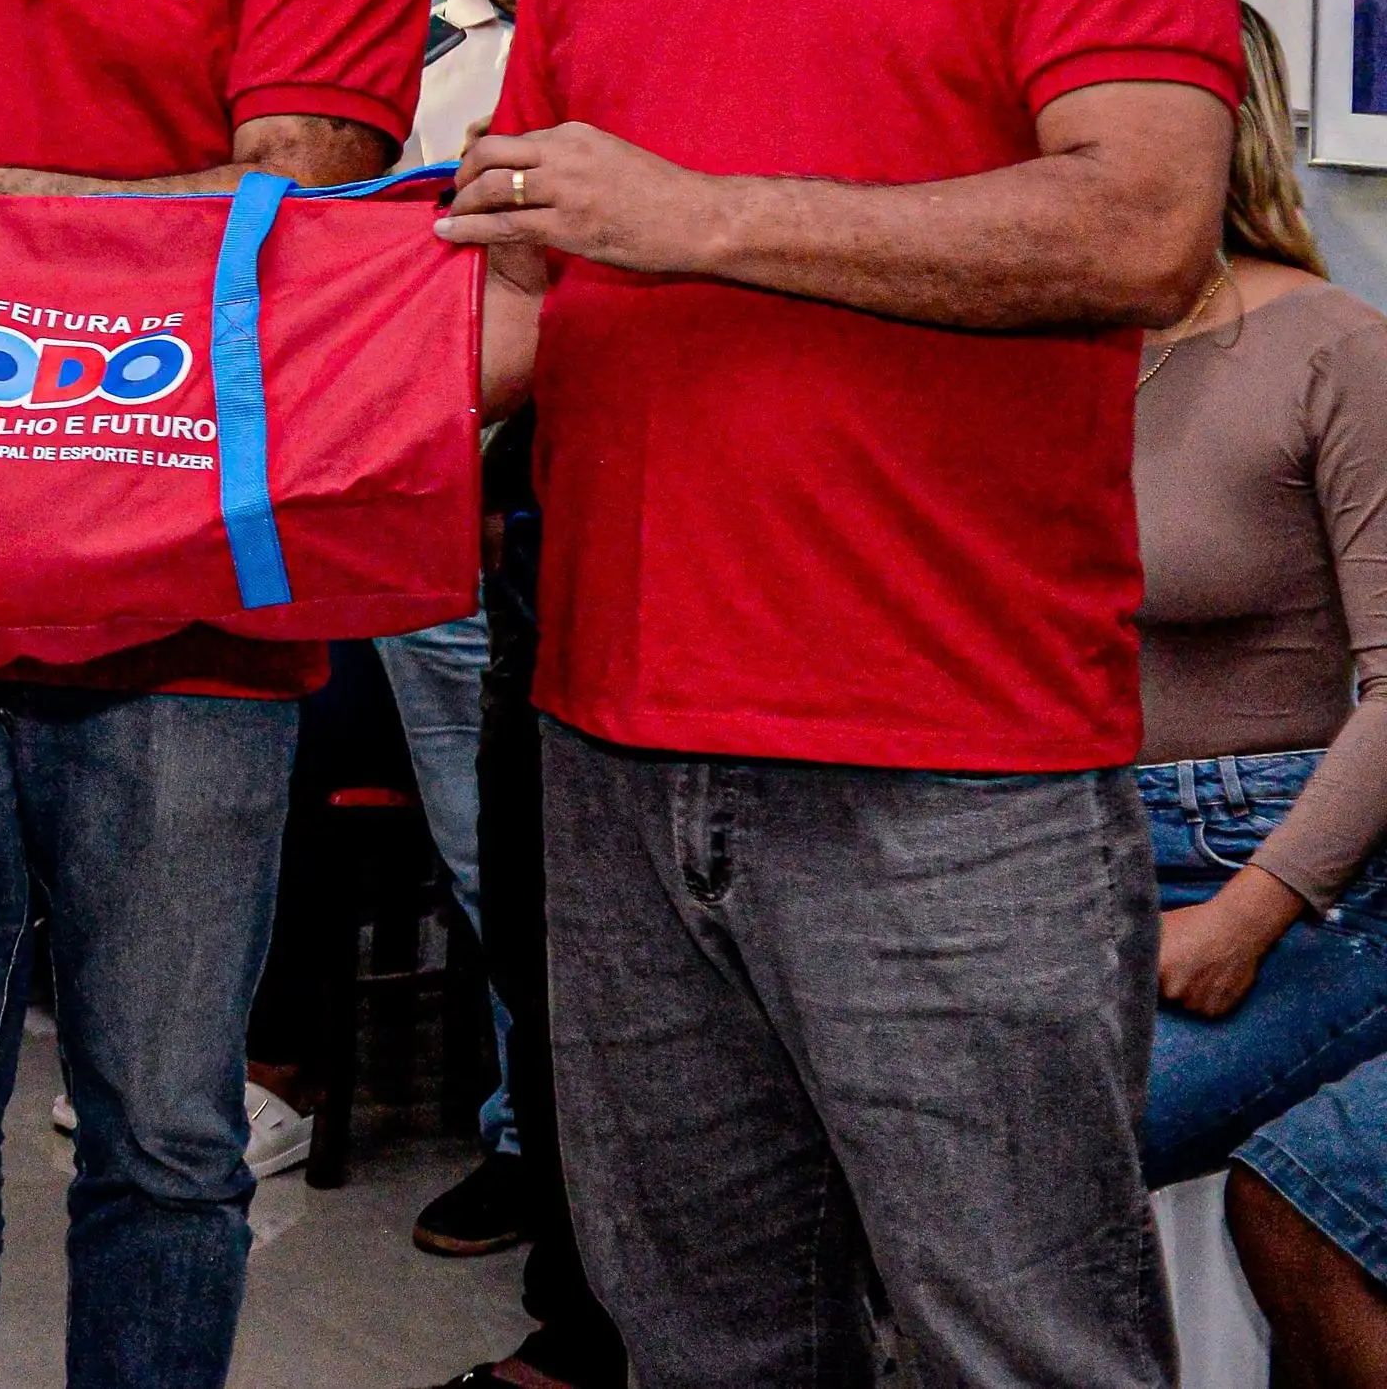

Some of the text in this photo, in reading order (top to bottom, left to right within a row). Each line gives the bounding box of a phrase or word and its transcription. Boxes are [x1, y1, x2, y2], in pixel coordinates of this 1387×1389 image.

[140, 312, 184, 332] DE
[65, 414, 85, 435] E
[92, 414, 217, 442] FUTURO
[32, 445, 56, 461] DE
[59, 447, 138, 465] ESPORTE
[142, 450, 153, 466] E
[157, 452, 214, 471] LAZER
